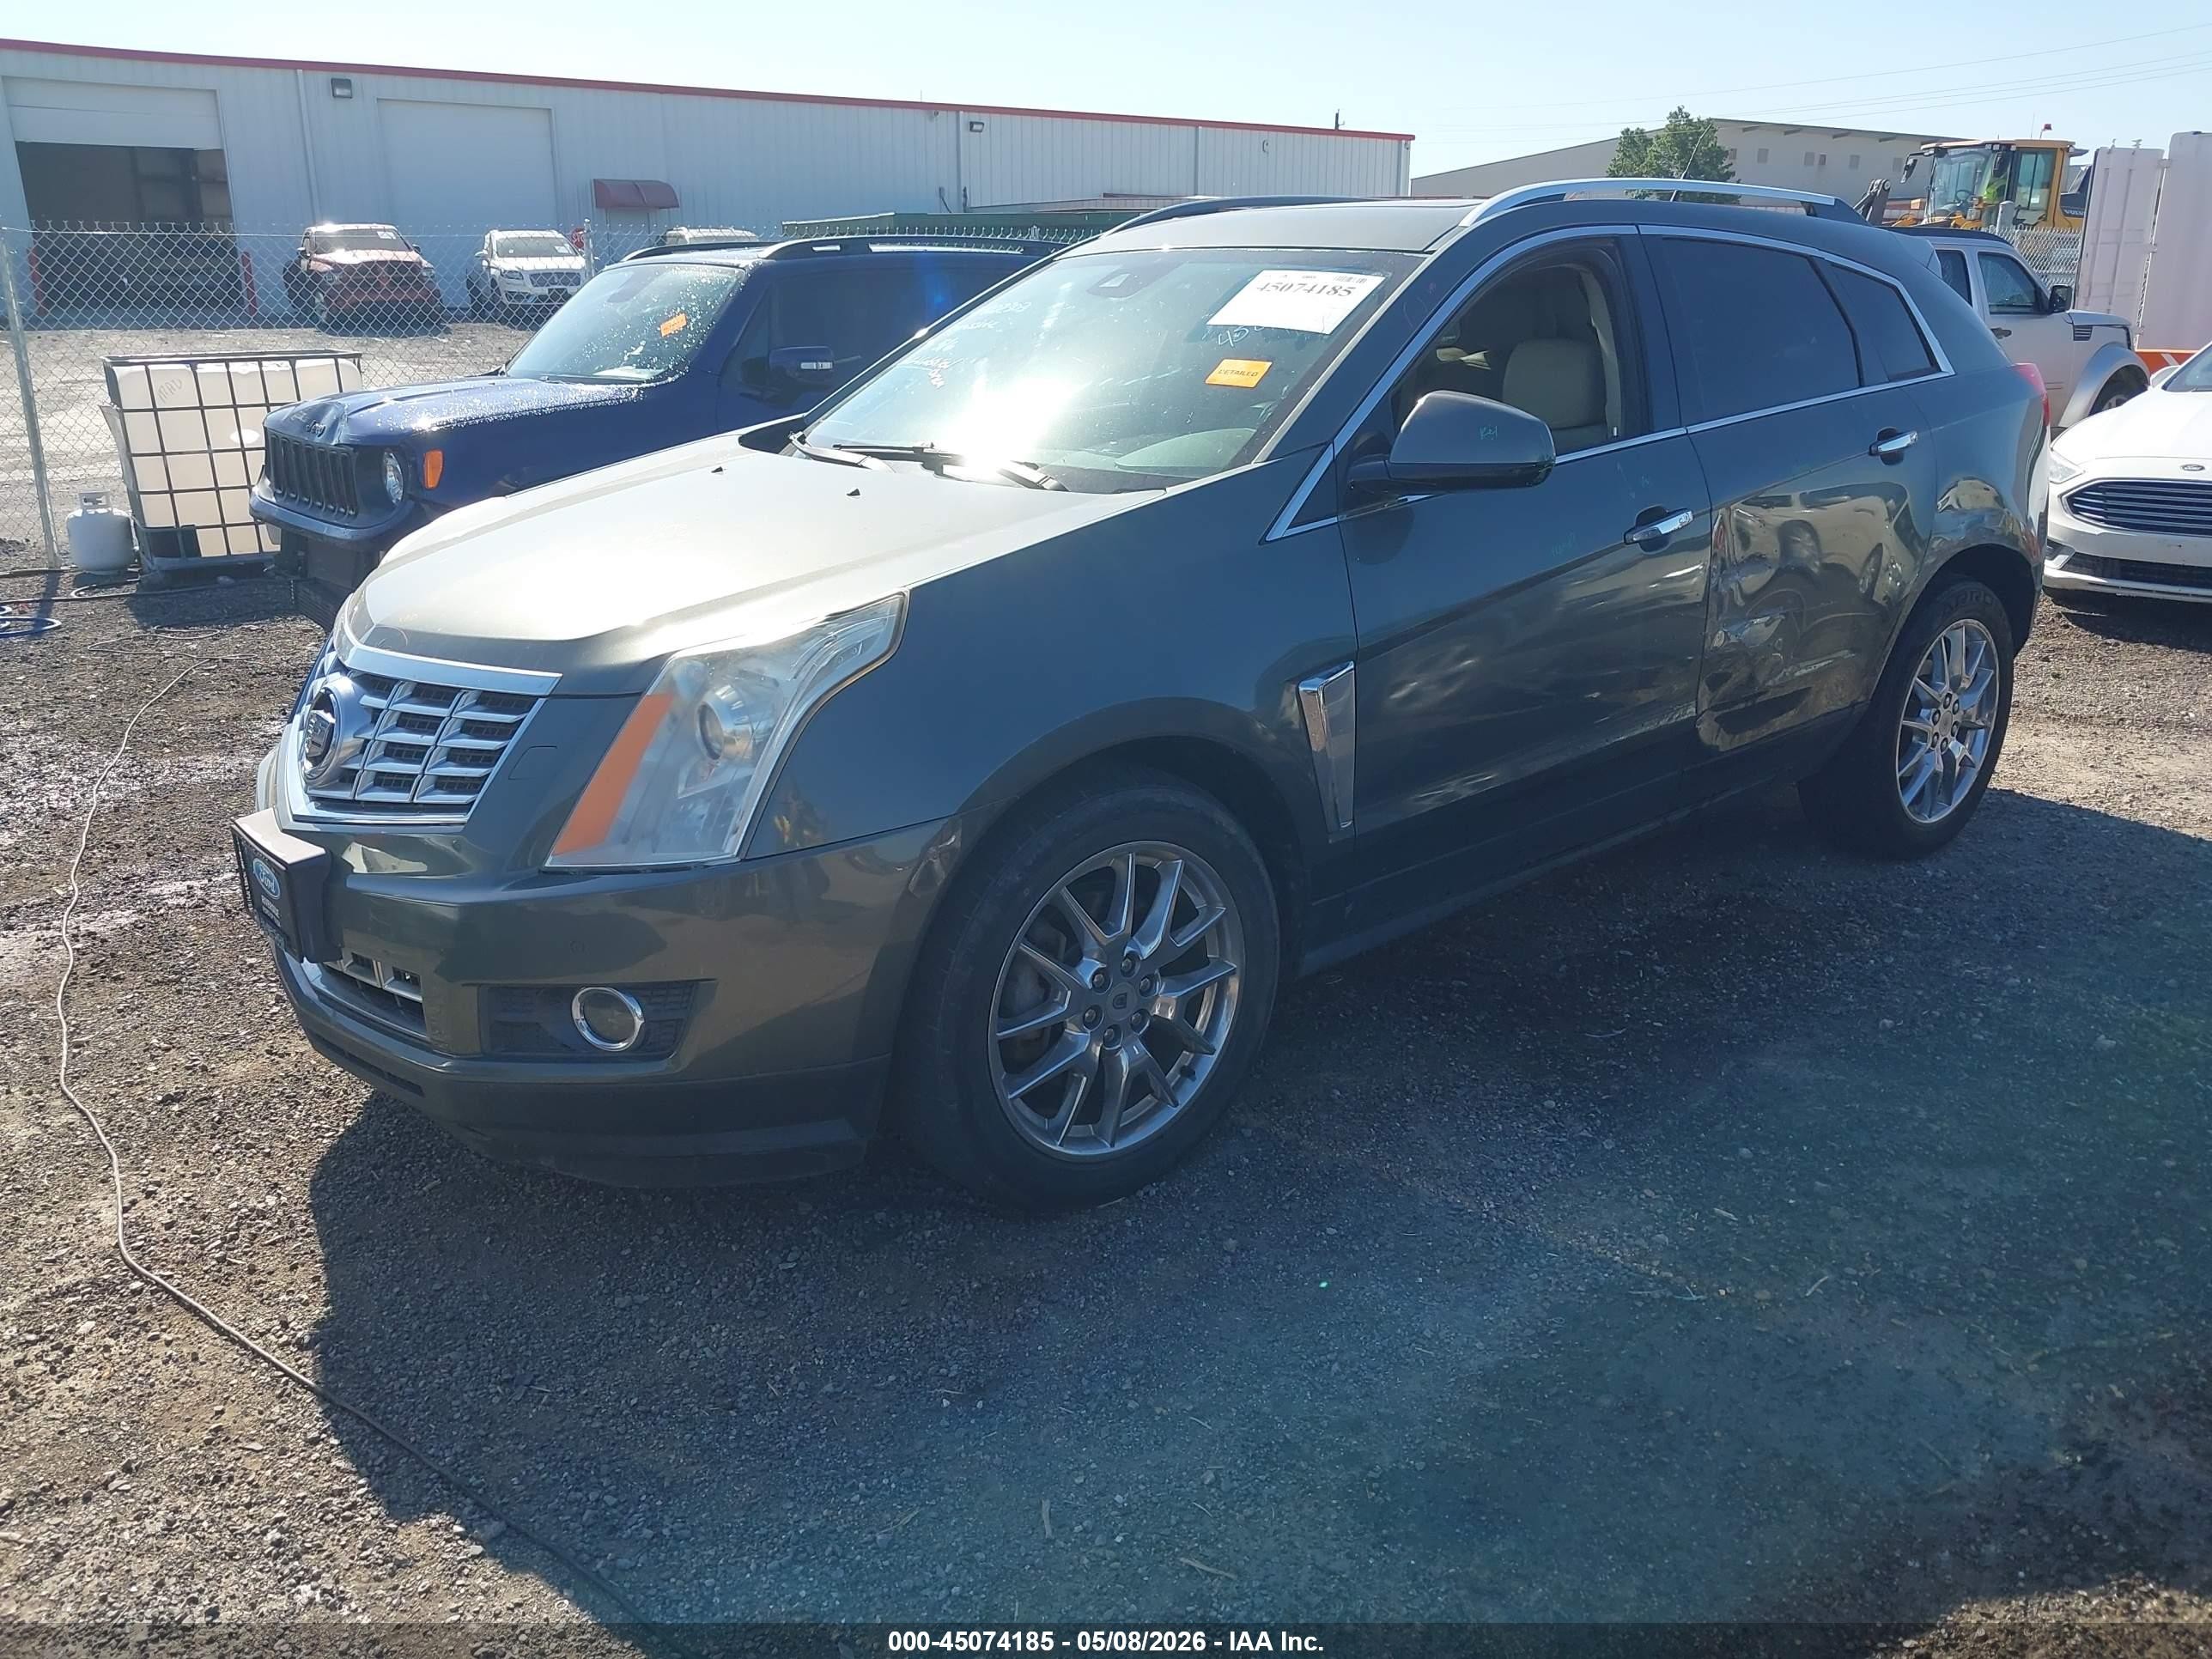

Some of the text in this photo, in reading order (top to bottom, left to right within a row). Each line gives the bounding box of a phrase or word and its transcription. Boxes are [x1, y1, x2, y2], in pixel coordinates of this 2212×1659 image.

[1256, 282, 1357, 297] 45074185
[1218, 369, 1259, 378] DETAILED
[259, 866, 276, 893] Ford
